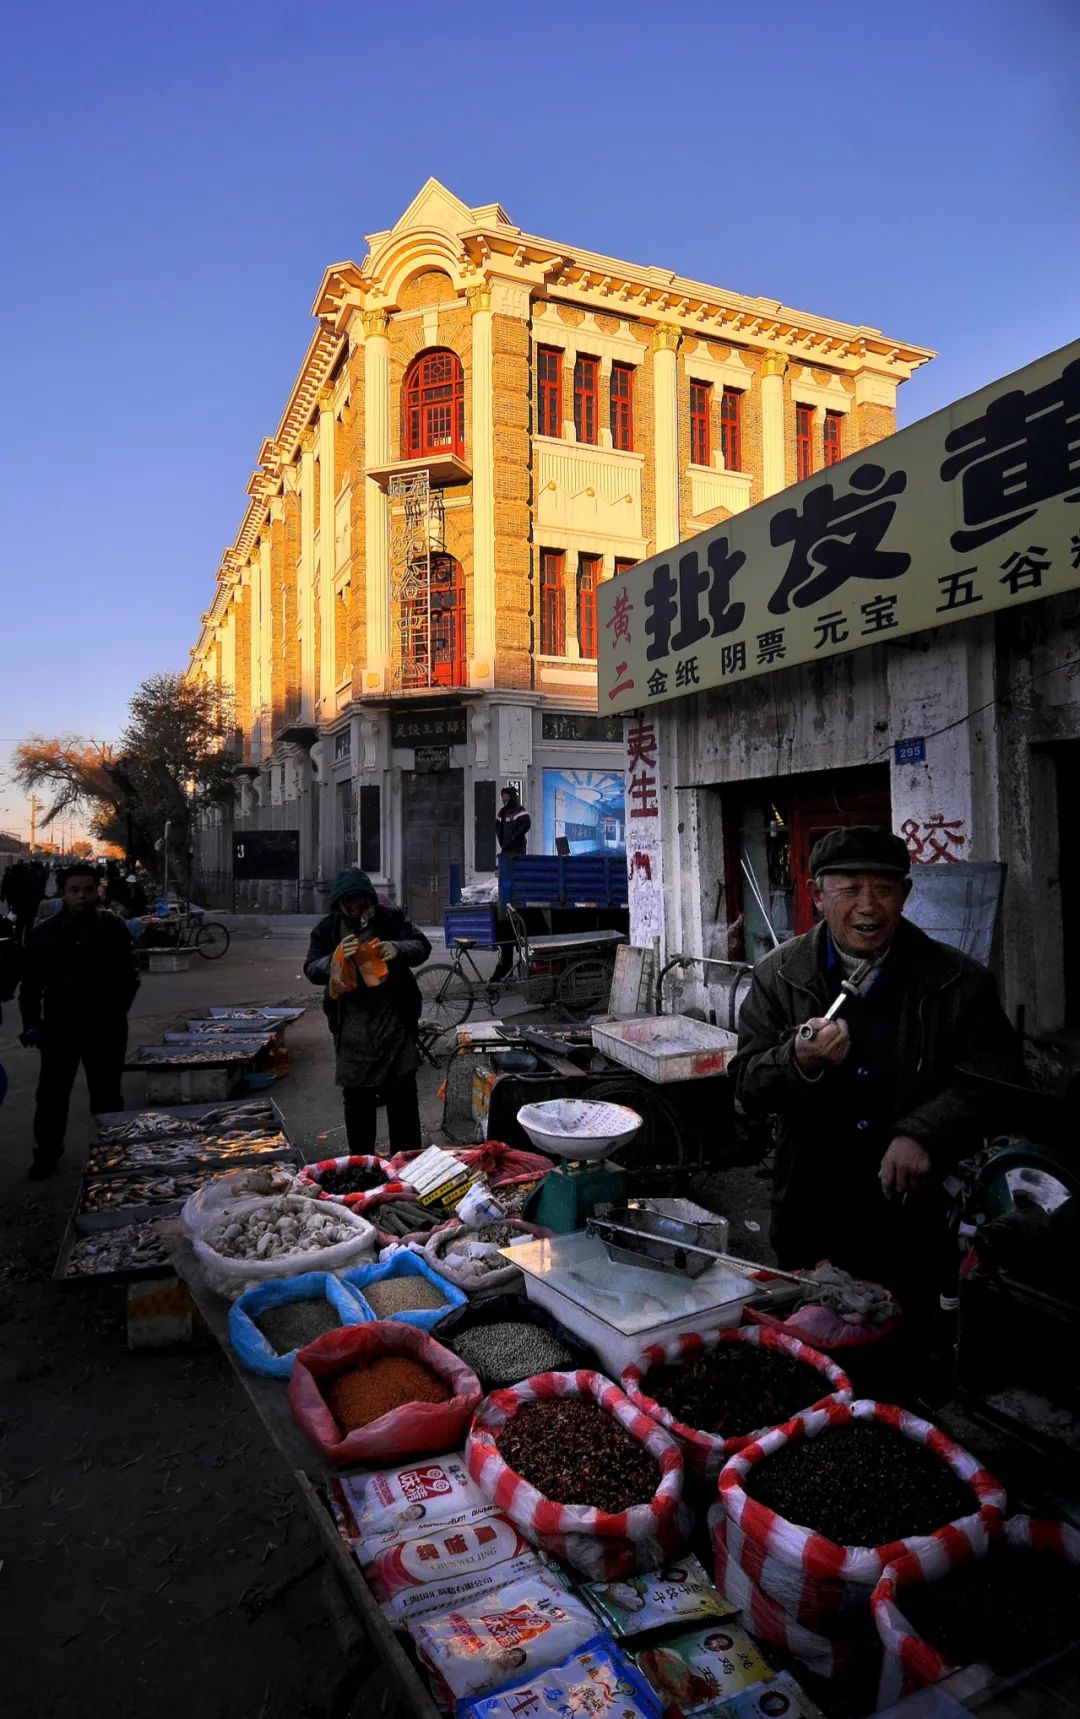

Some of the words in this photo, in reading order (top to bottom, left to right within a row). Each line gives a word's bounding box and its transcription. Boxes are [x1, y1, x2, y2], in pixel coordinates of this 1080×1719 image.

[647, 658, 700, 697] 金纸
[720, 627, 787, 675] 阴票
[814, 594, 900, 648] 元宝
[936, 529, 1080, 612] 五谷
[899, 746, 921, 759] 295
